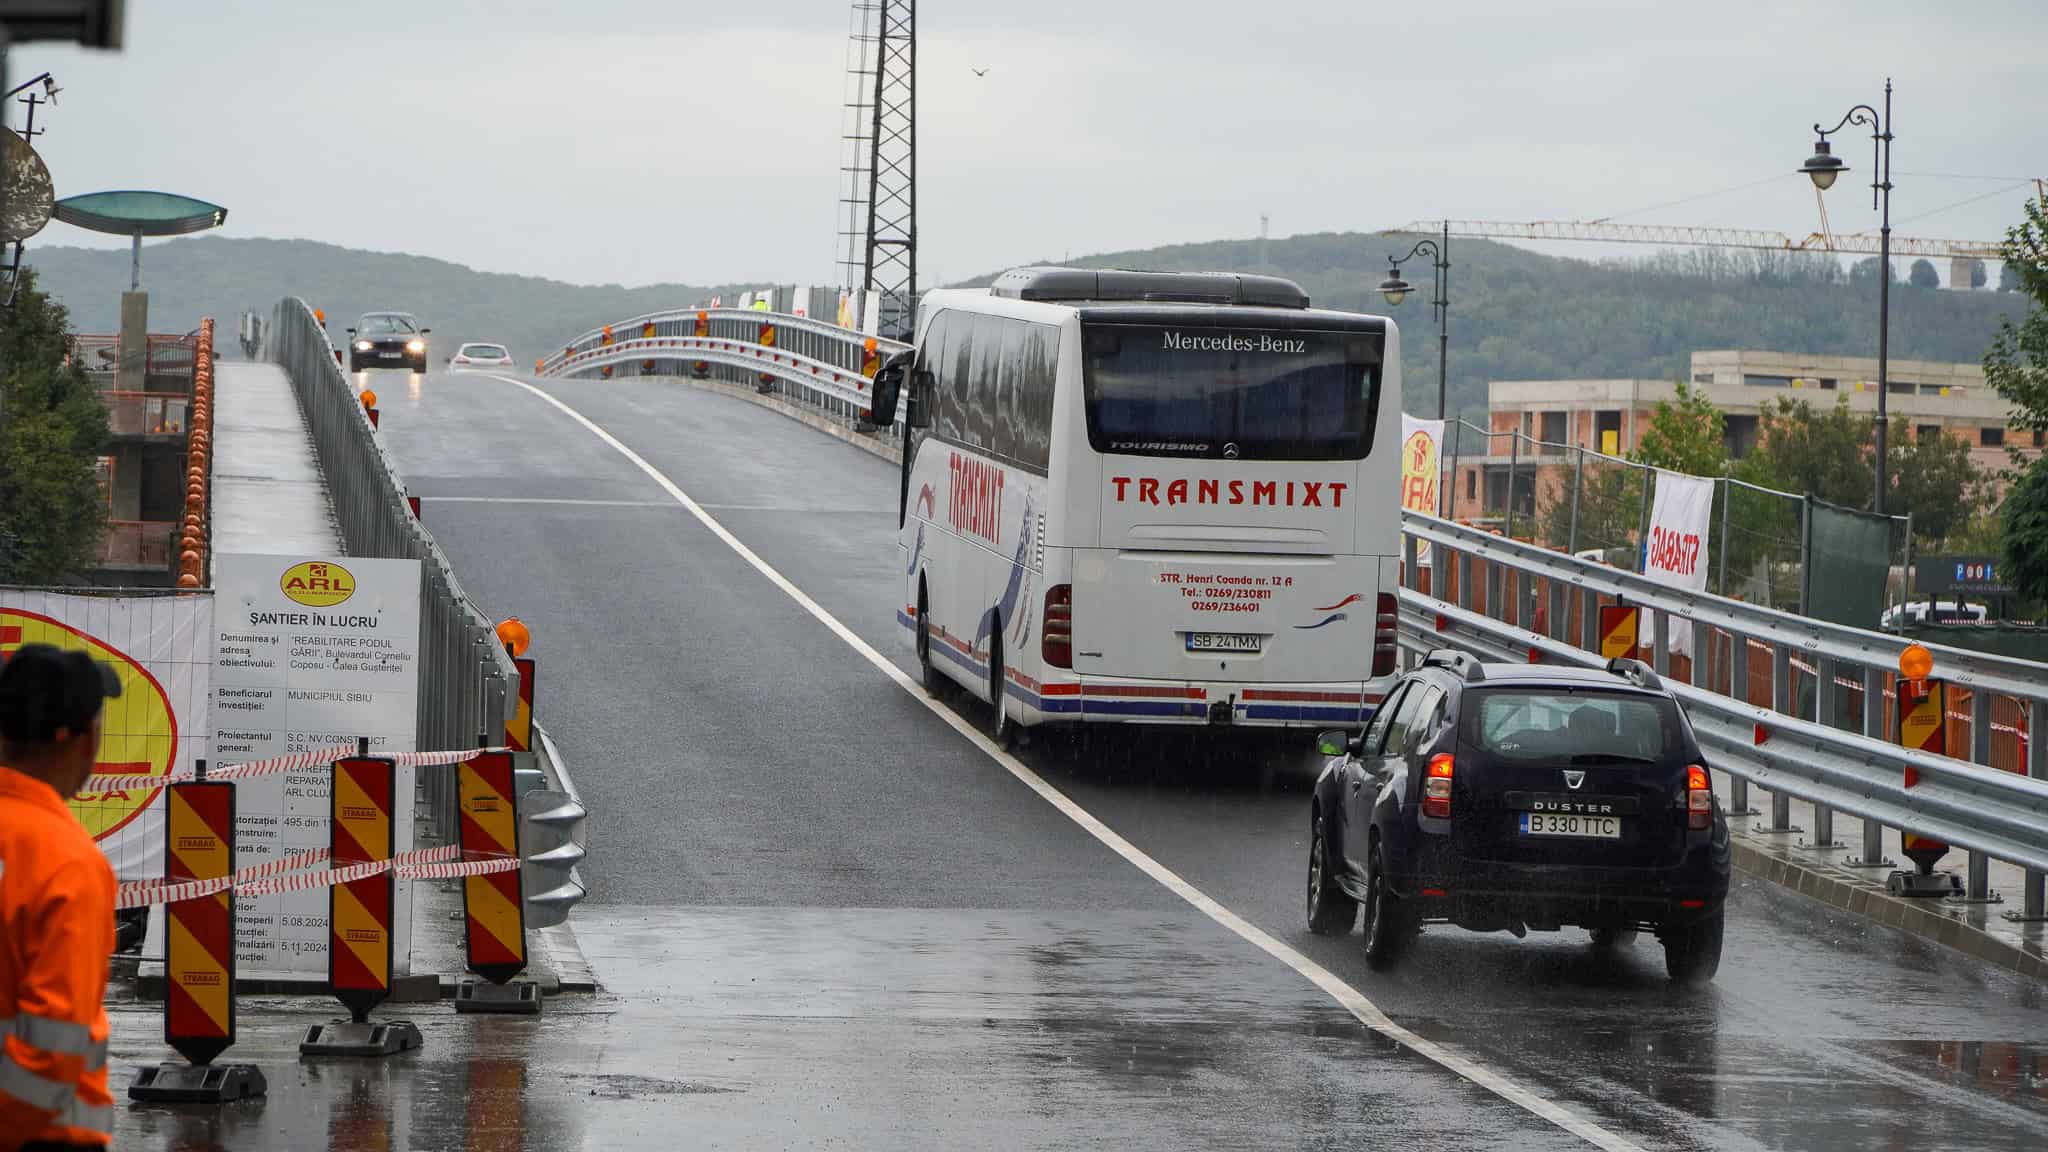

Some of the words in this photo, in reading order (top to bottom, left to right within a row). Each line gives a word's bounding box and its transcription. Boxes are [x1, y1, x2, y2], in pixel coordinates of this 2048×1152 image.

[1163, 331, 1305, 353] Mercedes-Benz
[1110, 440, 1209, 453] TOURISMO
[948, 451, 1004, 545] TRANSMIXT
[1112, 477, 1348, 508] TRANSMIXT
[287, 578, 352, 592] ARL
[1160, 573, 1183, 584] STR.
[1186, 573, 1213, 584] Henri
[1216, 574, 1252, 585] Coanda
[1255, 576, 1269, 586] nr.
[1272, 576, 1282, 586] 12
[1285, 576, 1293, 586] A
[1180, 587, 1202, 597] Tel.:
[1205, 588, 1271, 599] 0269/230811
[1192, 602, 1260, 612] 0269/236401
[312, 611, 326, 626] ÎN
[331, 615, 377, 628] LUCRU
[220, 633, 269, 643] Denumirea
[359, 638, 392, 648] PODUL
[1194, 635, 1211, 647] SB
[326, 649, 372, 660] Bulevardul
[290, 660, 324, 671] Coposu
[219, 688, 272, 698] Beneficiarul
[288, 690, 344, 702] MUNICIPIUL
[346, 692, 372, 702] SIBIU
[218, 730, 272, 741] Proiectantul
[309, 734, 324, 743] NV
[325, 735, 387, 745] CONSTUCT
[1534, 801, 1613, 813] DUSTER
[1531, 816, 1543, 832] B
[1548, 817, 1577, 833] 330
[1583, 818, 1614, 834] TTC
